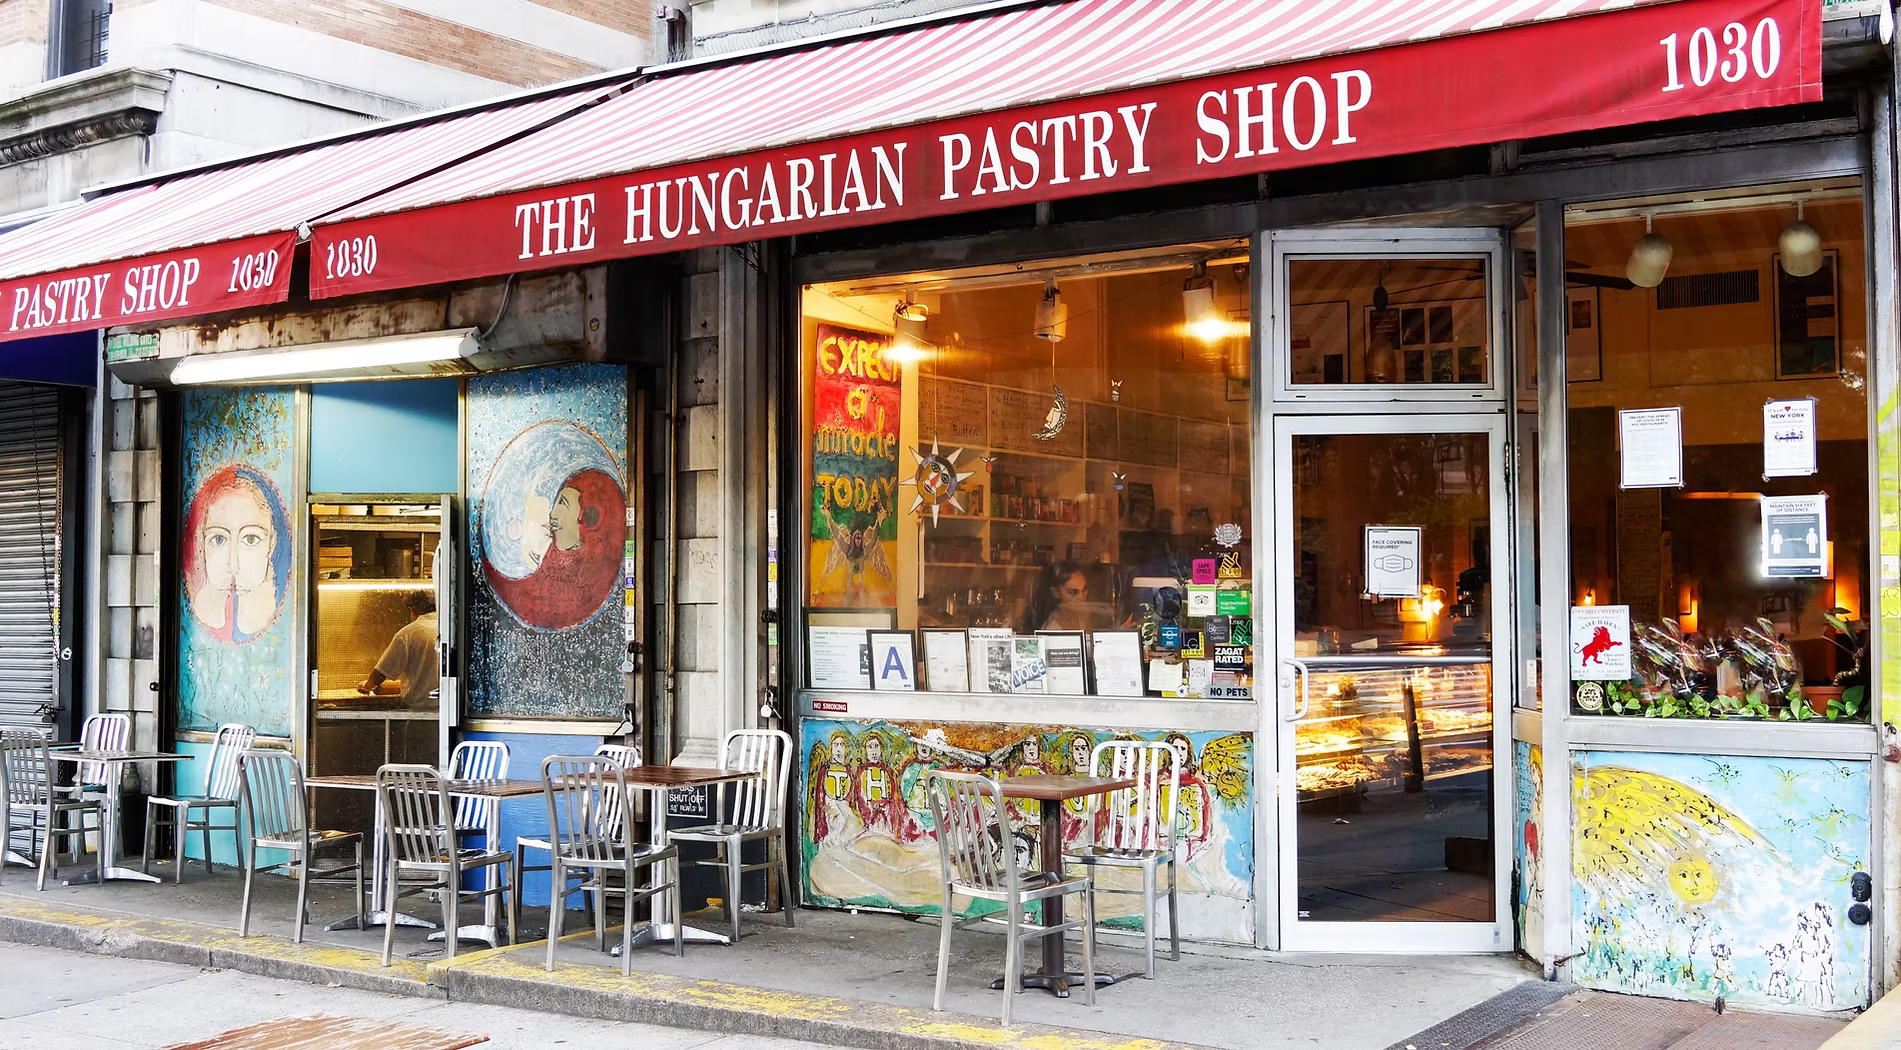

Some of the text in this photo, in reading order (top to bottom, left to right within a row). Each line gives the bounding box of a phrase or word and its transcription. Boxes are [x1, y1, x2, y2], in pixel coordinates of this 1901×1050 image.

[1660, 17, 1781, 92] 1030
[515, 69, 1372, 260] THE HUNGARIAN PASTRY SHOP
[326, 235, 378, 280] 1030
[9, 249, 279, 332] PASTRY SHOP 1030
[817, 407, 896, 461] miracle
[816, 473, 897, 517] TODAY
[881, 646, 908, 680] A
[1214, 647, 1244, 656] ZAGAT
[1214, 655, 1244, 664] RATED
[1014, 659, 1046, 686] VOICE
[822, 702, 847, 711] SMOKING
[1210, 687, 1248, 697] NO PETS
[669, 794, 688, 802] SHUT
